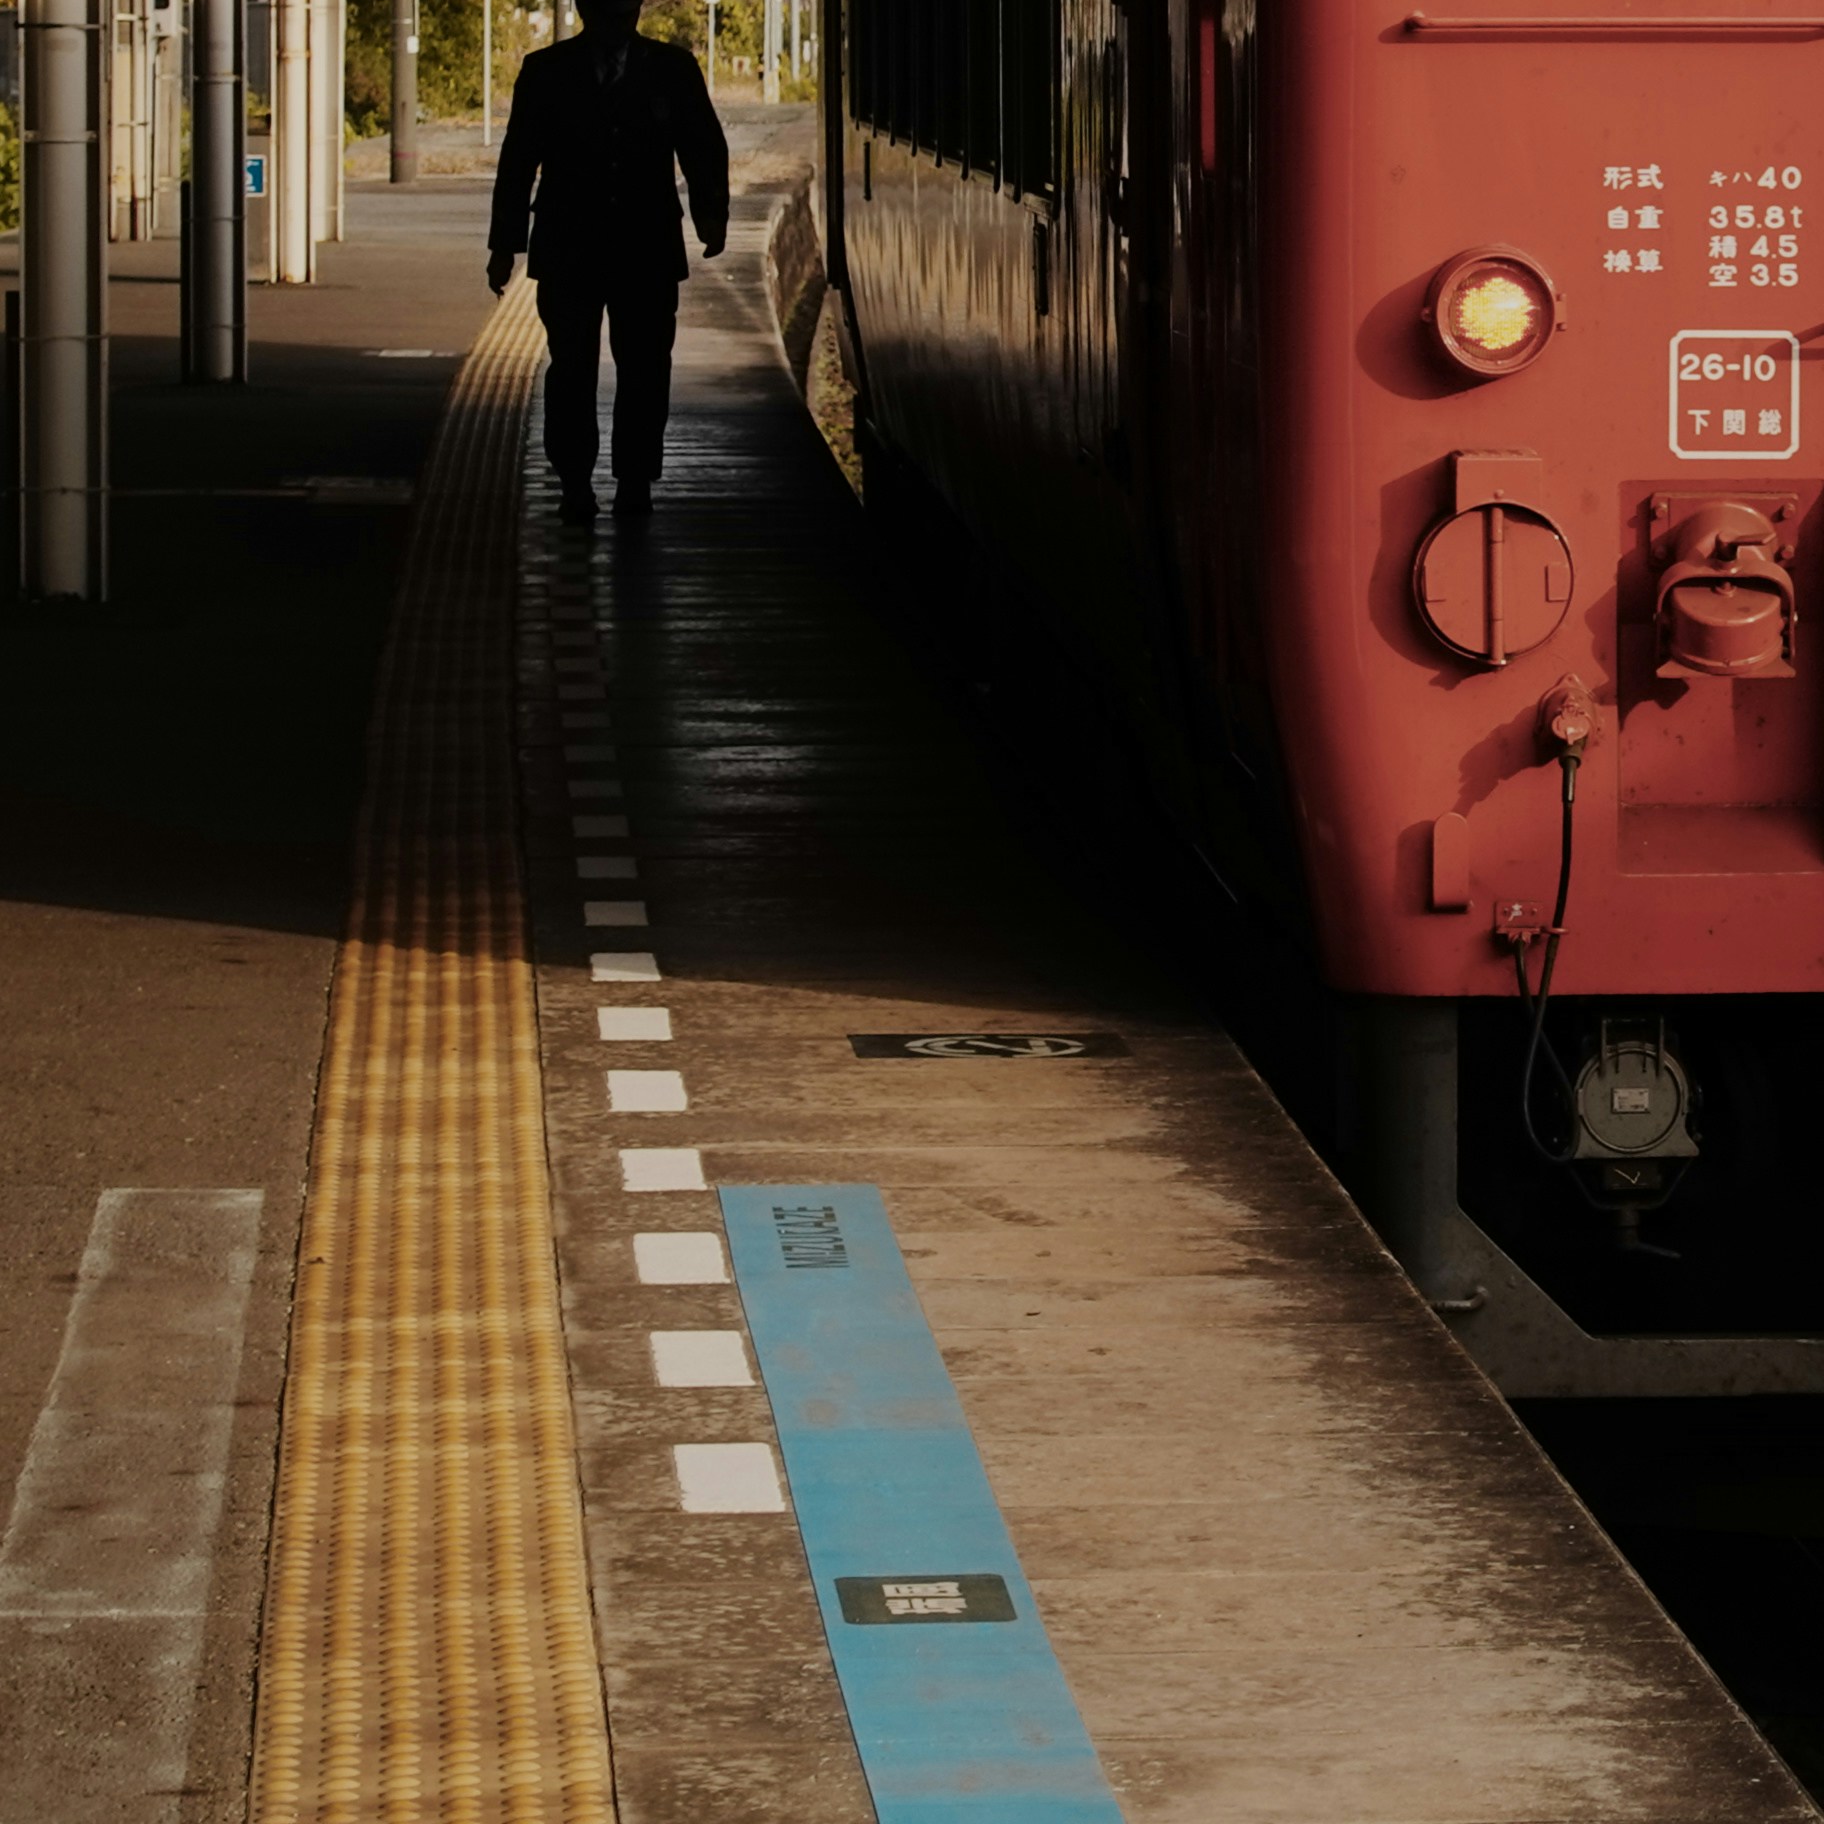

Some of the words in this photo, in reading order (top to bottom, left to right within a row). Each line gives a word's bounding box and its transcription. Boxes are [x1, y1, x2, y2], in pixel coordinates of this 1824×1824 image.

[1603, 164, 1663, 190] 形式
[1709, 166, 1802, 190] キハ40
[1606, 206, 1663, 229] 自重
[1603, 249, 1663, 273] 換算
[1679, 354, 1776, 381] 26-10
[1687, 409, 1782, 435] 下関総
